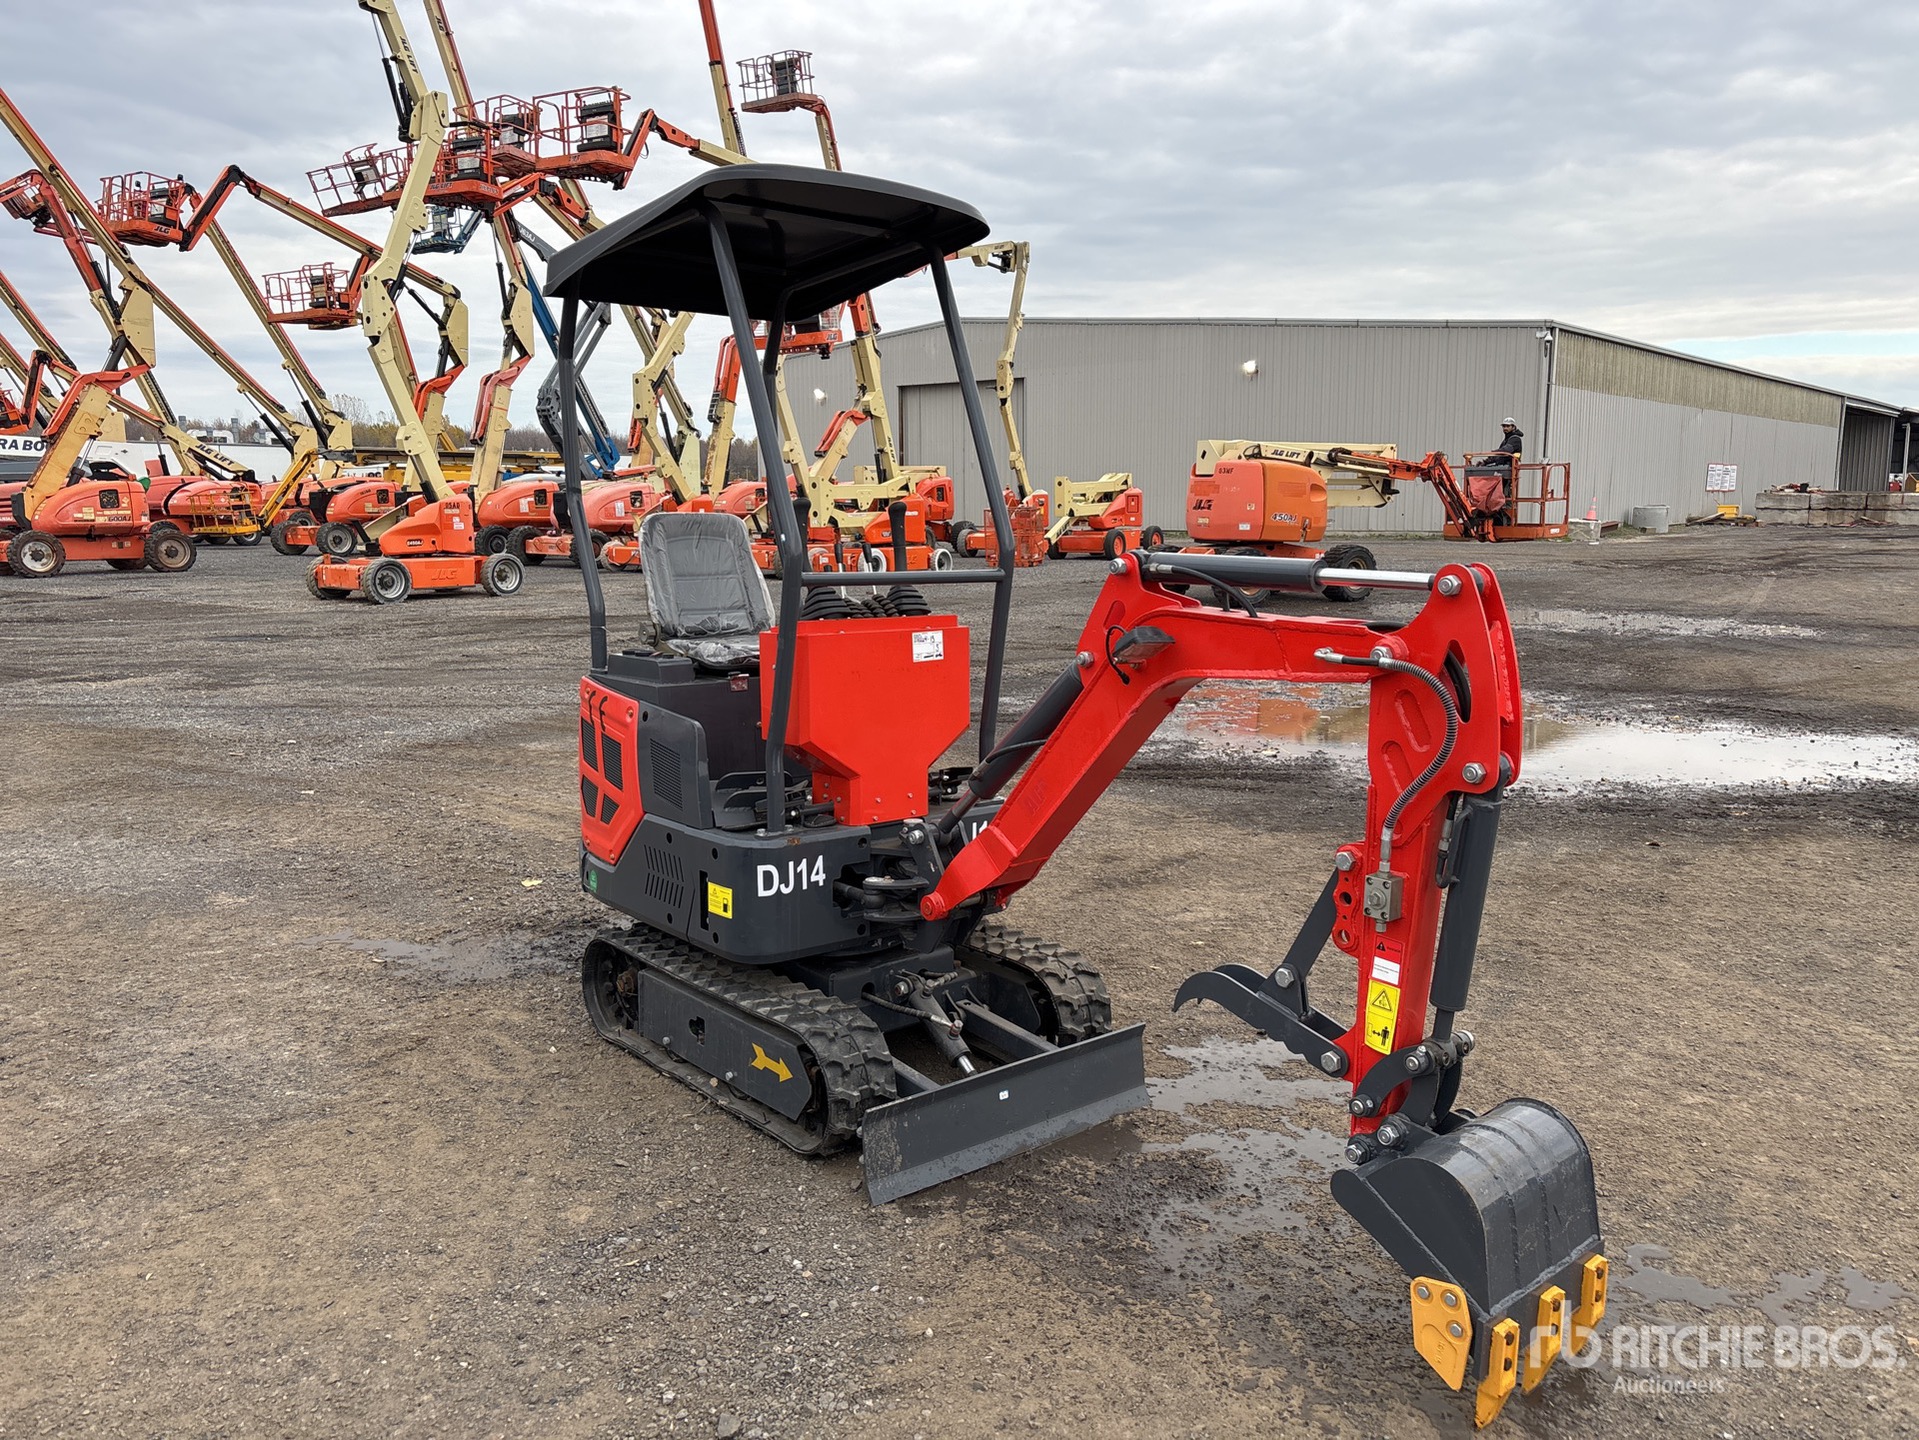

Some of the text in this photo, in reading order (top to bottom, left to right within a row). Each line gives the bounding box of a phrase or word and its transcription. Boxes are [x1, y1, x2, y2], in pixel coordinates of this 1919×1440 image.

[399, 35, 411, 53] JLG
[153, 226, 171, 235] JLG
[195, 443, 235, 466] JLG LIFT
[1271, 449, 1301, 459] JLG LIFT
[1192, 498, 1214, 511] JLG
[1271, 513, 1298, 522] 450AJ
[756, 854, 827, 898] DJ14
